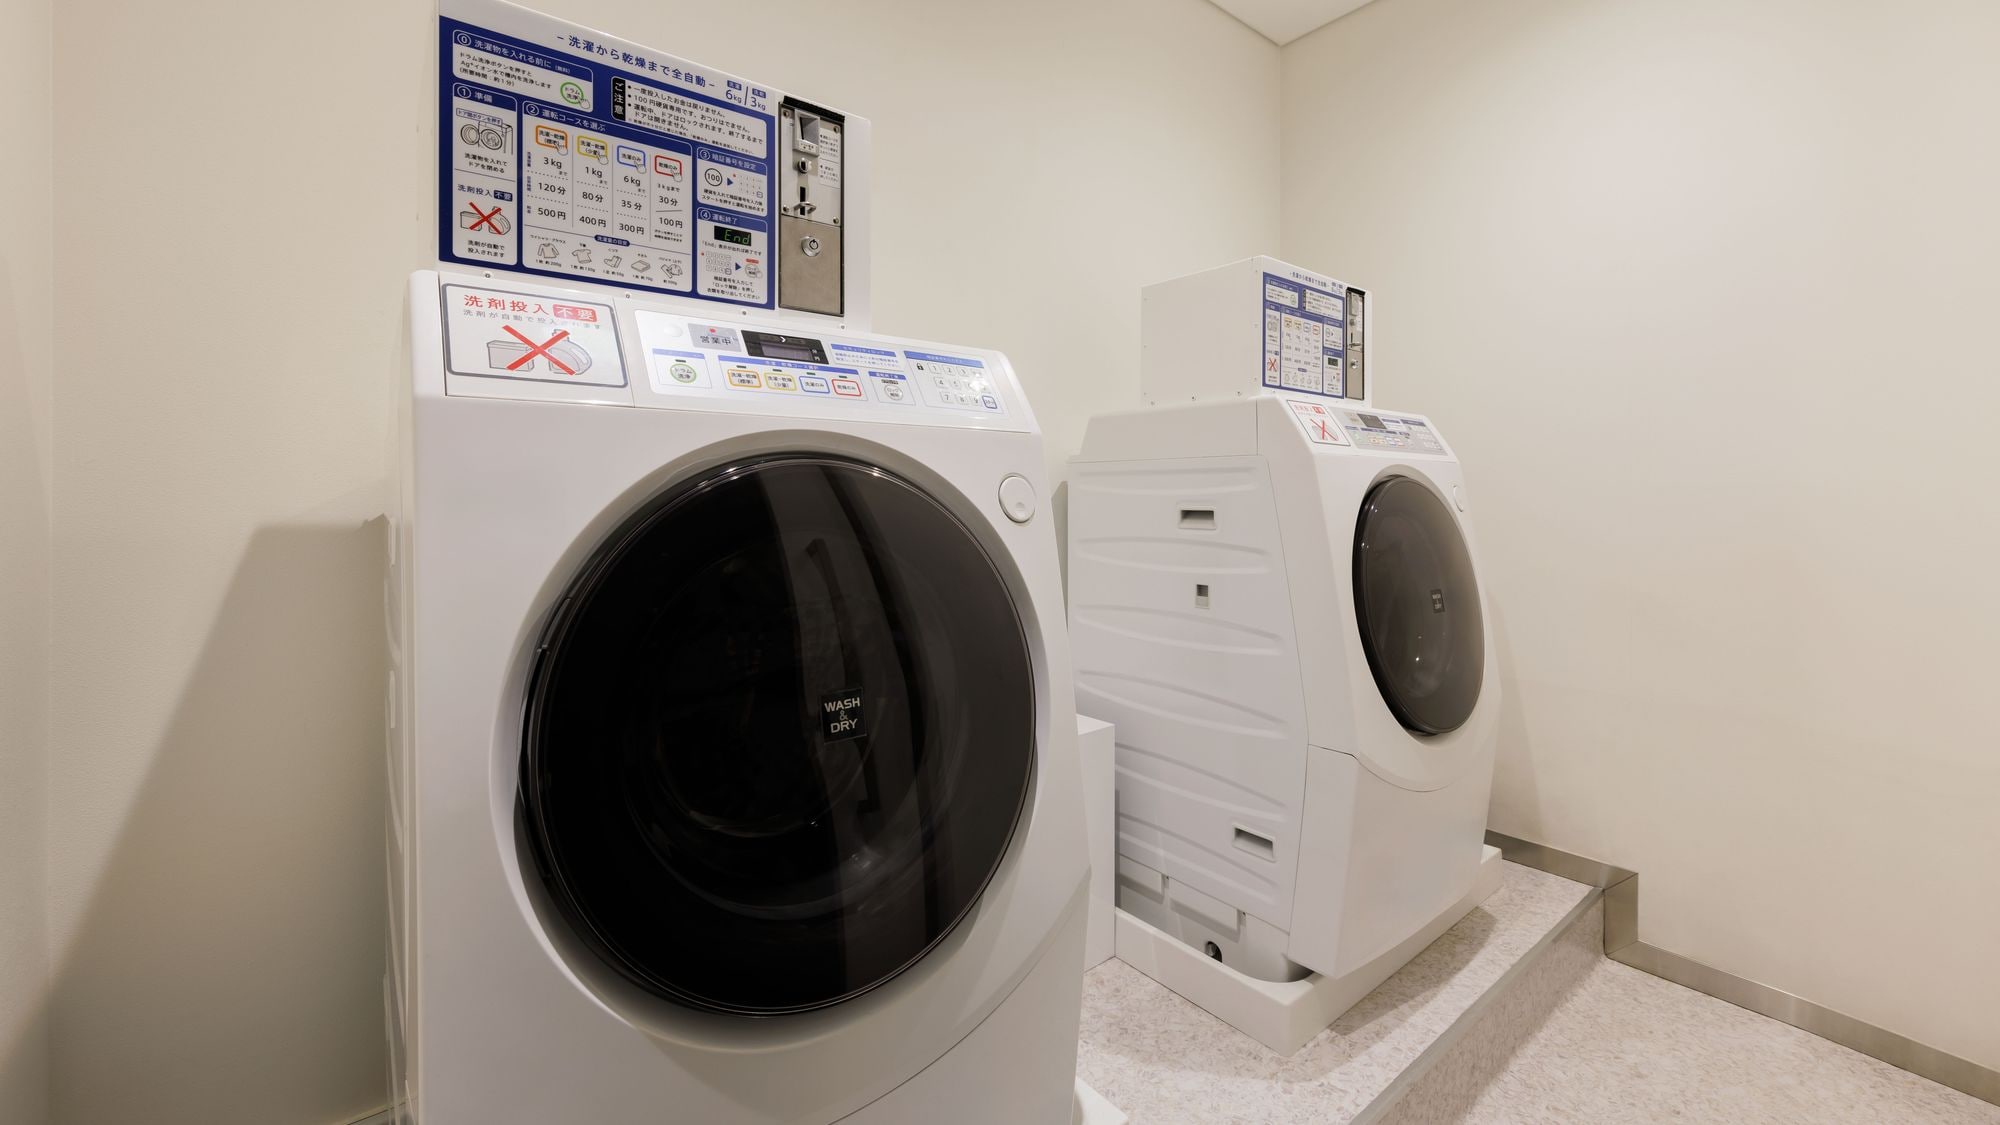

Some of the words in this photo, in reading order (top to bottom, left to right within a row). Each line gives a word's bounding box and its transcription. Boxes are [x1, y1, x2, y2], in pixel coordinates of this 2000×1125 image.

[474, 40, 552, 68] 洗濯物を入れる前に
[460, 52, 532, 77] ドラム洗浄ボタンを押すと
[614, 82, 625, 115] ご注意
[633, 87, 726, 118] 一度投入したお金は戻りません。
[542, 110, 606, 132] 運転コースを選ぶ
[635, 111, 689, 132] ドアは開きません。
[712, 153, 757, 170] 暗証番号を設定
[457, 184, 493, 198] 洗剤投入
[495, 191, 512, 201] 不要
[712, 212, 738, 225] 運転終了
[468, 240, 505, 250] 洗剤が自動で
[724, 230, 751, 245] End
[468, 248, 504, 258] 投入されます
[464, 294, 550, 316] 洗剤投入
[557, 306, 593, 322] 不要
[700, 335, 732, 346] 営業中
[824, 696, 860, 713] WASH
[840, 710, 848, 721] &
[830, 718, 858, 734] DRY
